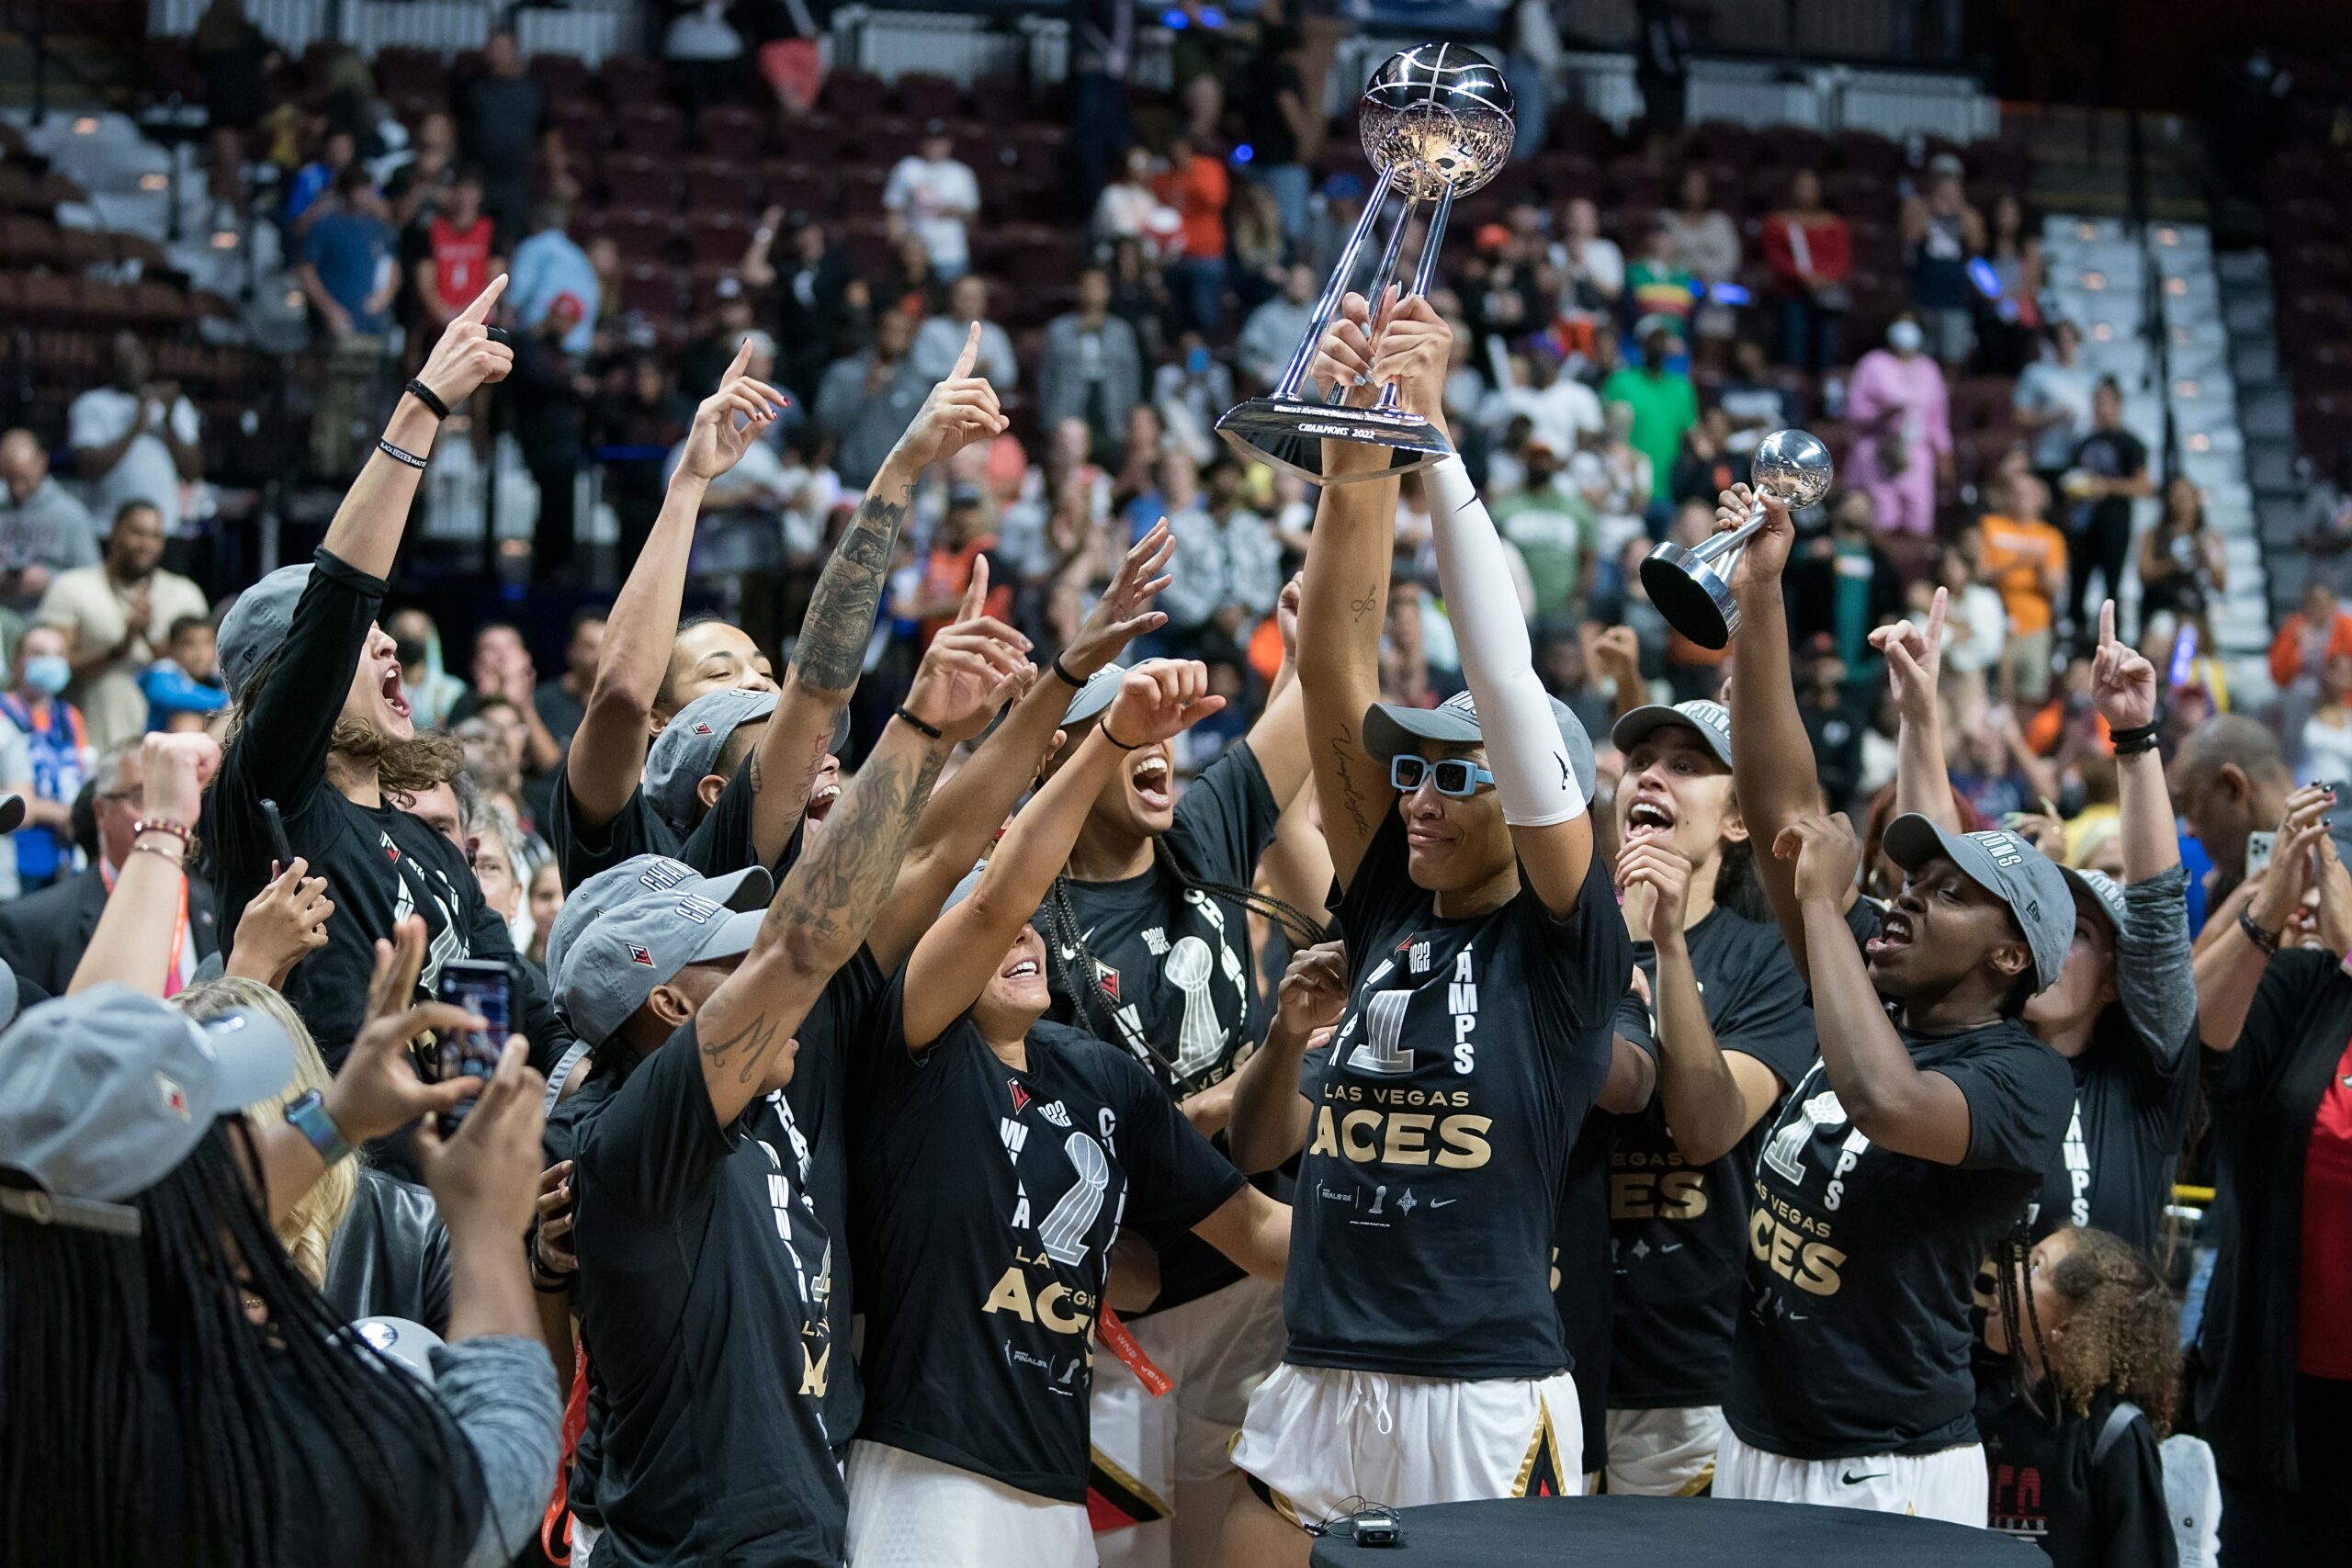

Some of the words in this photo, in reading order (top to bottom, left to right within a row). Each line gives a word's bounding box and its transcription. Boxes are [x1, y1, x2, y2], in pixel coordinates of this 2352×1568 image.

[1297, 423, 1349, 436] CHAMPIONS
[1351, 429, 1375, 439] 2022
[379, 441, 394, 454] BLACK
[394, 449, 411, 462] LIVES
[1964, 831, 2022, 867] IONS
[1448, 942, 1478, 1075] AMPS
[1325, 1083, 1363, 1101] LAS
[1374, 1088, 1470, 1107] VEGAS
[1310, 1105, 1493, 1169] ACES
[1611, 1152, 1684, 1168] EGAS
[1824, 1126, 1871, 1212] MPS
[1611, 1171, 1708, 1220] ES
[1771, 1194, 1832, 1238] VEGAS
[1015, 1246, 1054, 1269] LA
[1750, 1207, 1848, 1296] CES
[1116, 1333, 1138, 1359] WNB
[1995, 1518, 2045, 1531] EGAS
